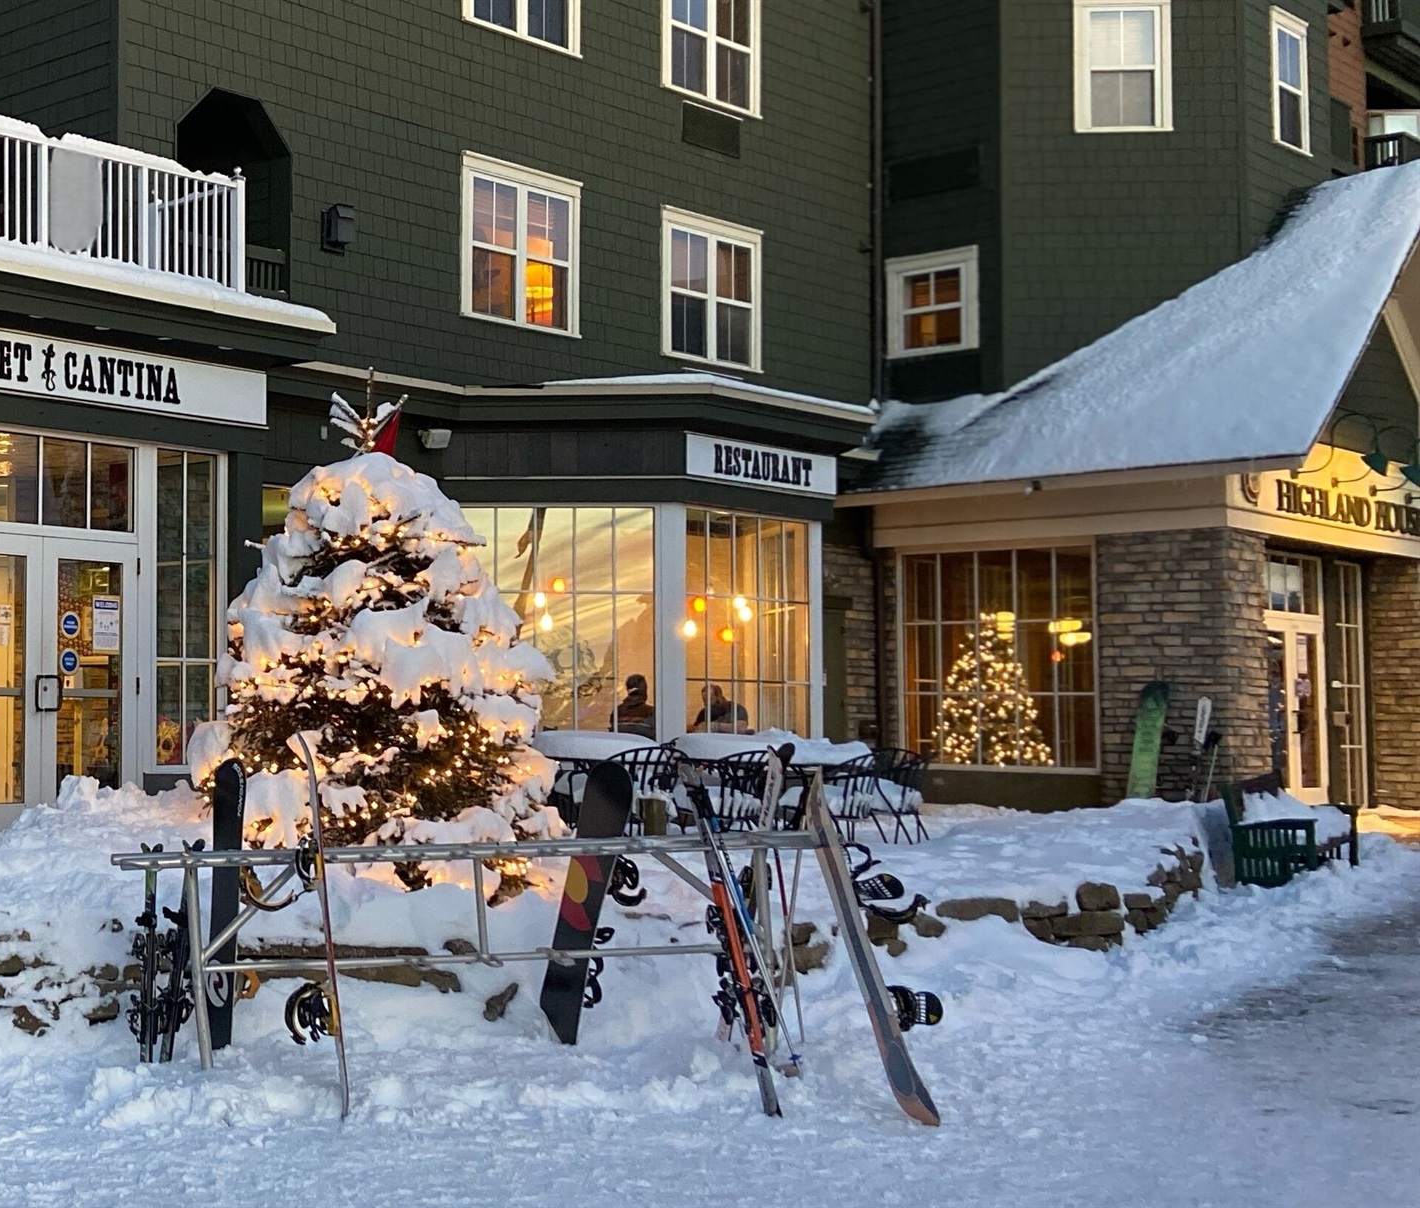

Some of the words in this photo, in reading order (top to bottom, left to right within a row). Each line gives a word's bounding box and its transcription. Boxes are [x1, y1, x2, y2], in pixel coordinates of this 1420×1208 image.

[64, 351, 181, 404] CANTINA
[713, 443, 813, 487] RESTAURANT
[1275, 478, 1372, 527] HIGHLAND
